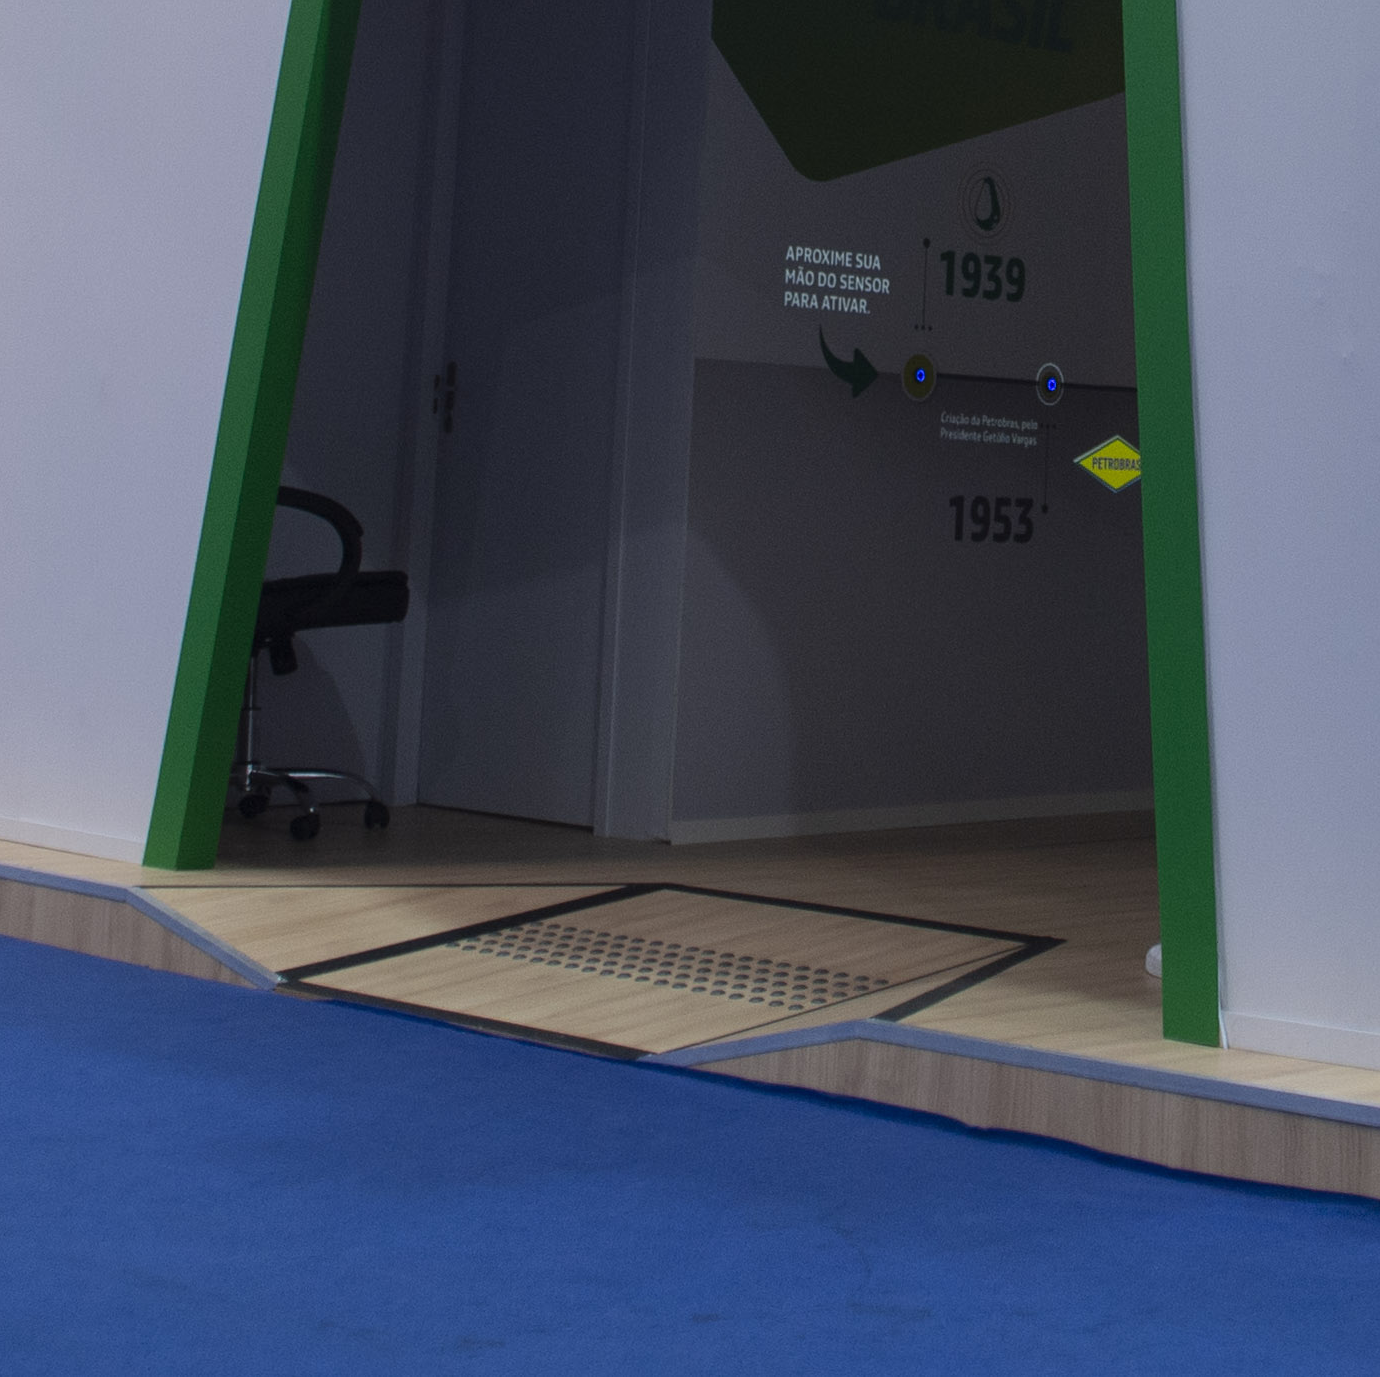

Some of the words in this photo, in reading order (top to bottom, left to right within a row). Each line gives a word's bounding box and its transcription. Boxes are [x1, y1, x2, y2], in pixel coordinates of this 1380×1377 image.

[785, 245, 853, 268] APROXIME
[855, 253, 881, 271] SUA
[785, 266, 815, 287] MÃO
[818, 271, 837, 288] DO
[840, 274, 891, 295] SENSOR
[940, 249, 1027, 303] 1939
[784, 291, 819, 310] PARA
[821, 295, 871, 315] ATIVAR.
[941, 411, 970, 426] Criação
[940, 426, 981, 442] Presidente
[1011, 432, 1038, 447] Vargas
[1092, 456, 1140, 472] PETROBRAS
[949, 495, 1035, 544] 1953
